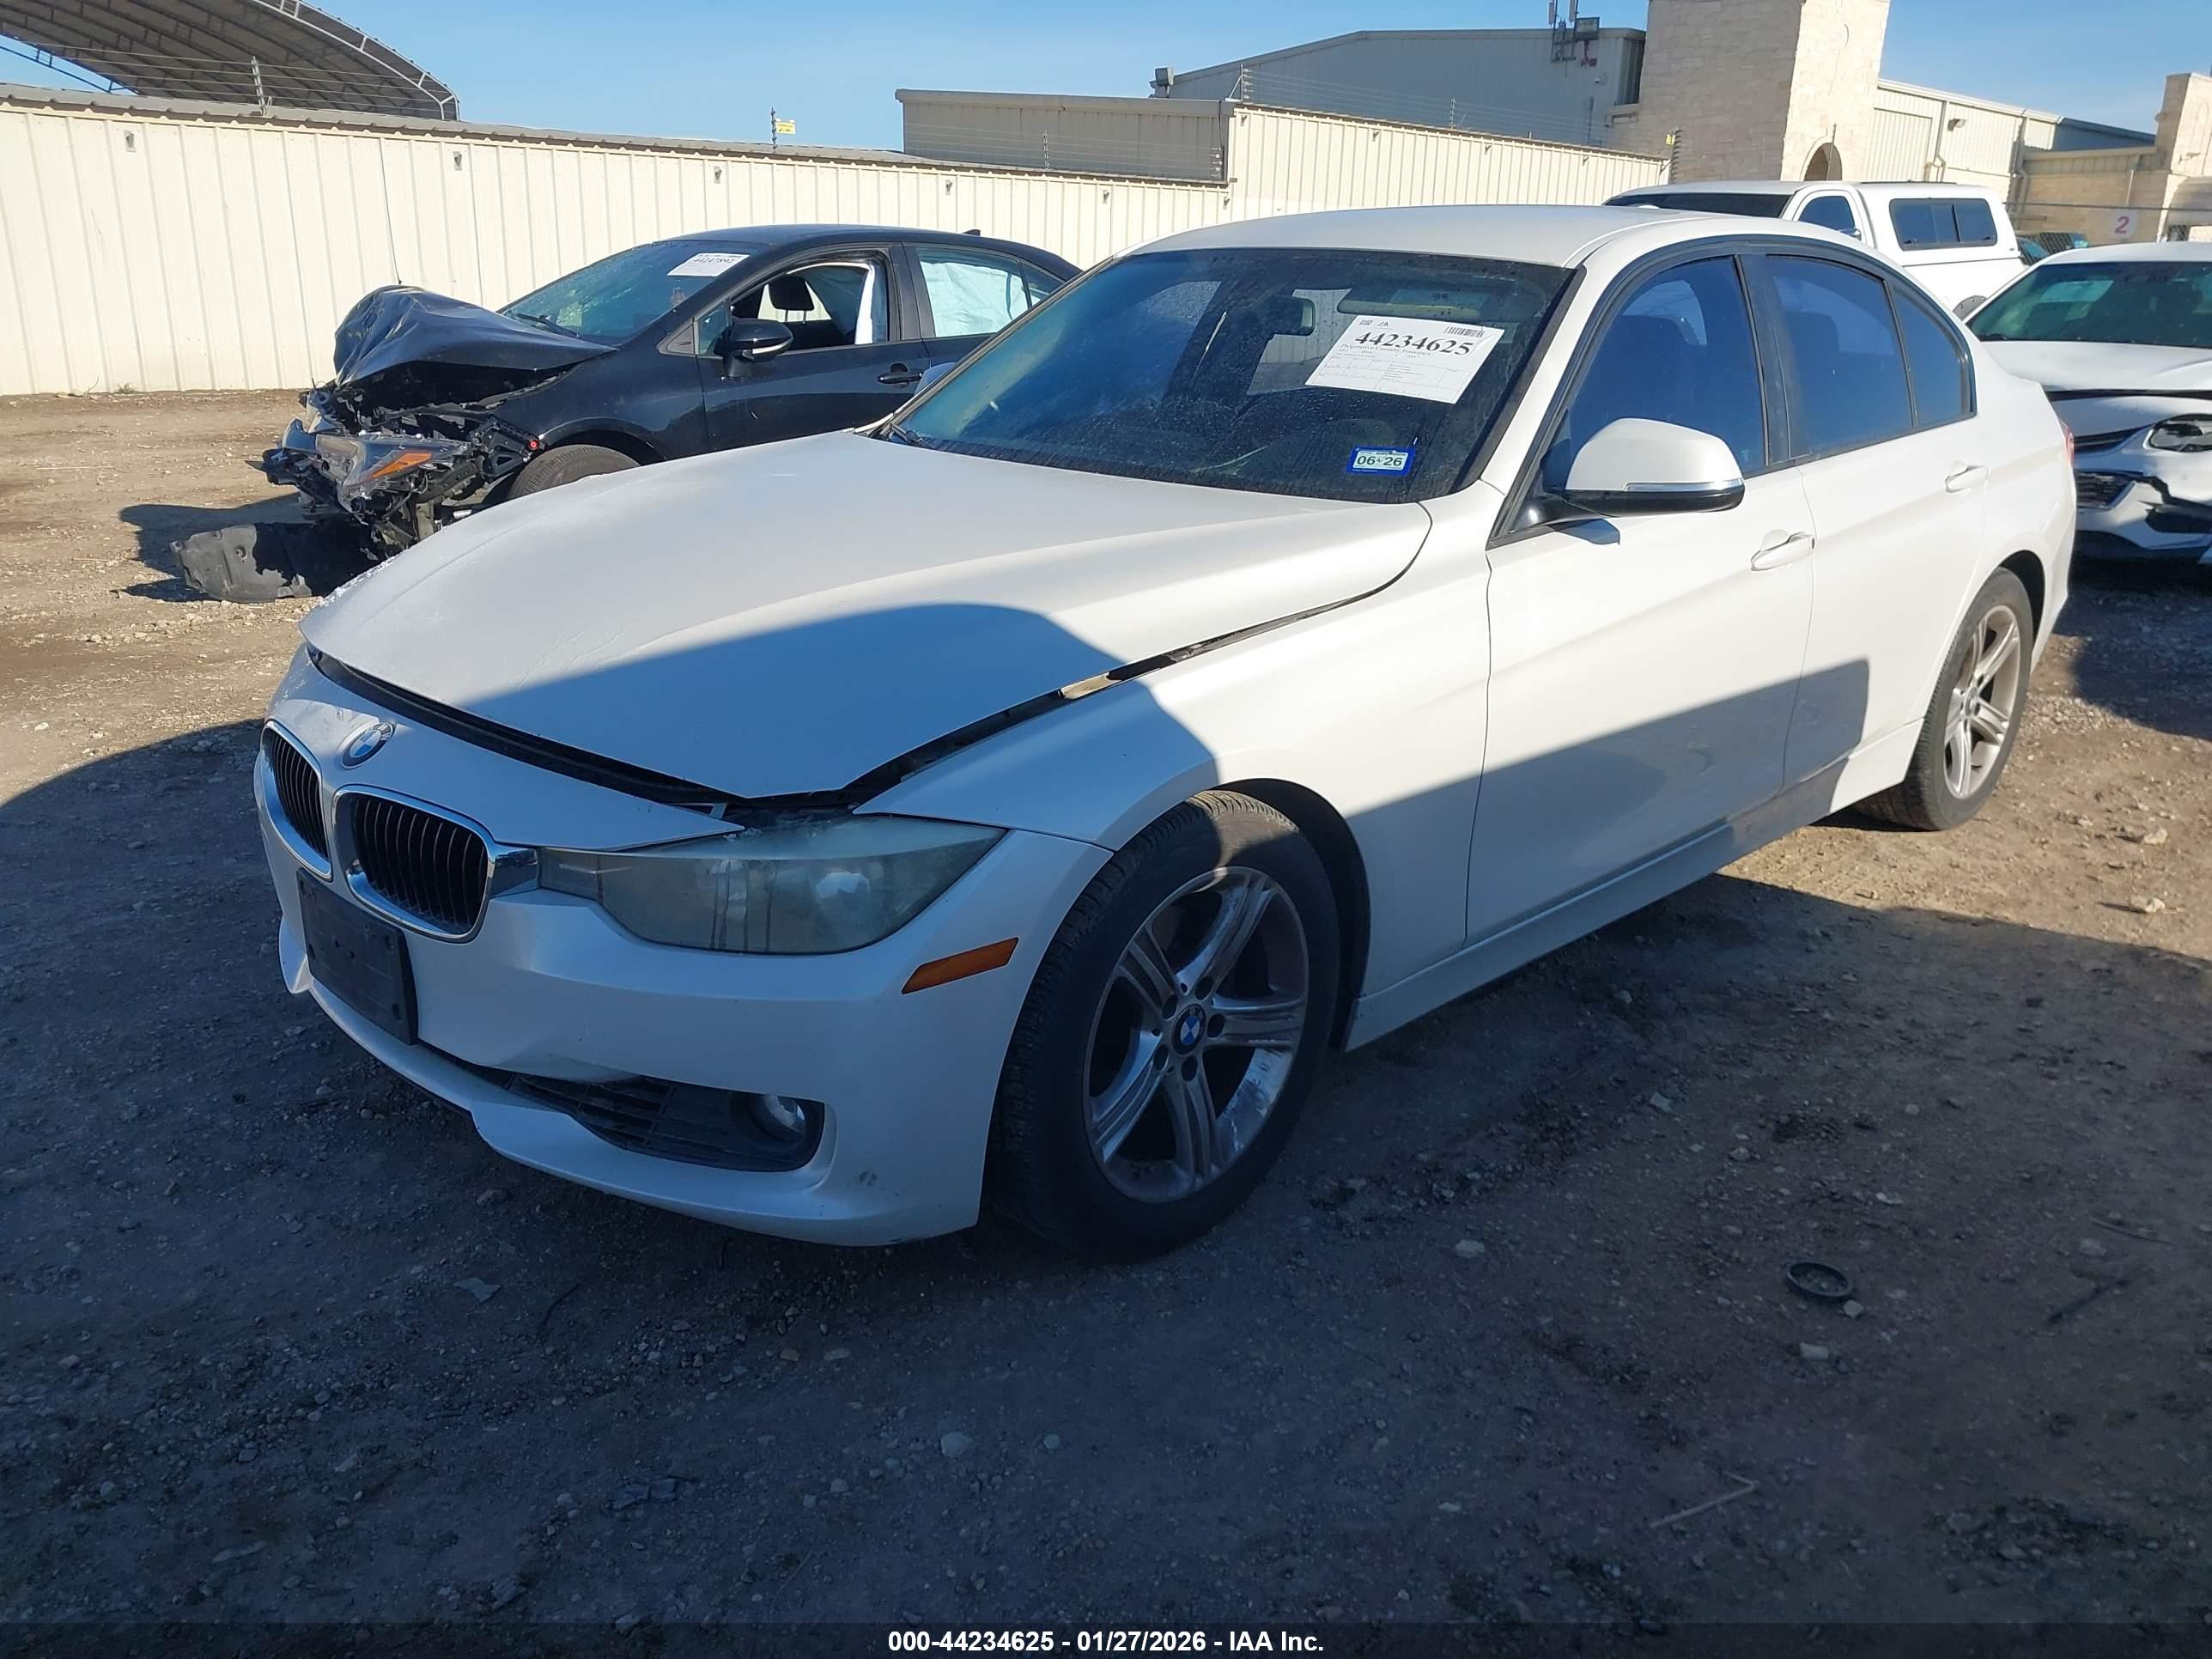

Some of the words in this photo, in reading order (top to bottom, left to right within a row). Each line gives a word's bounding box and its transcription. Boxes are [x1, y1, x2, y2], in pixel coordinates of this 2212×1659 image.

[2114, 216, 2130, 234] 2
[1355, 331, 1475, 356] 44234625
[1357, 455, 1376, 465] 06
[1382, 456, 1403, 466] 26
